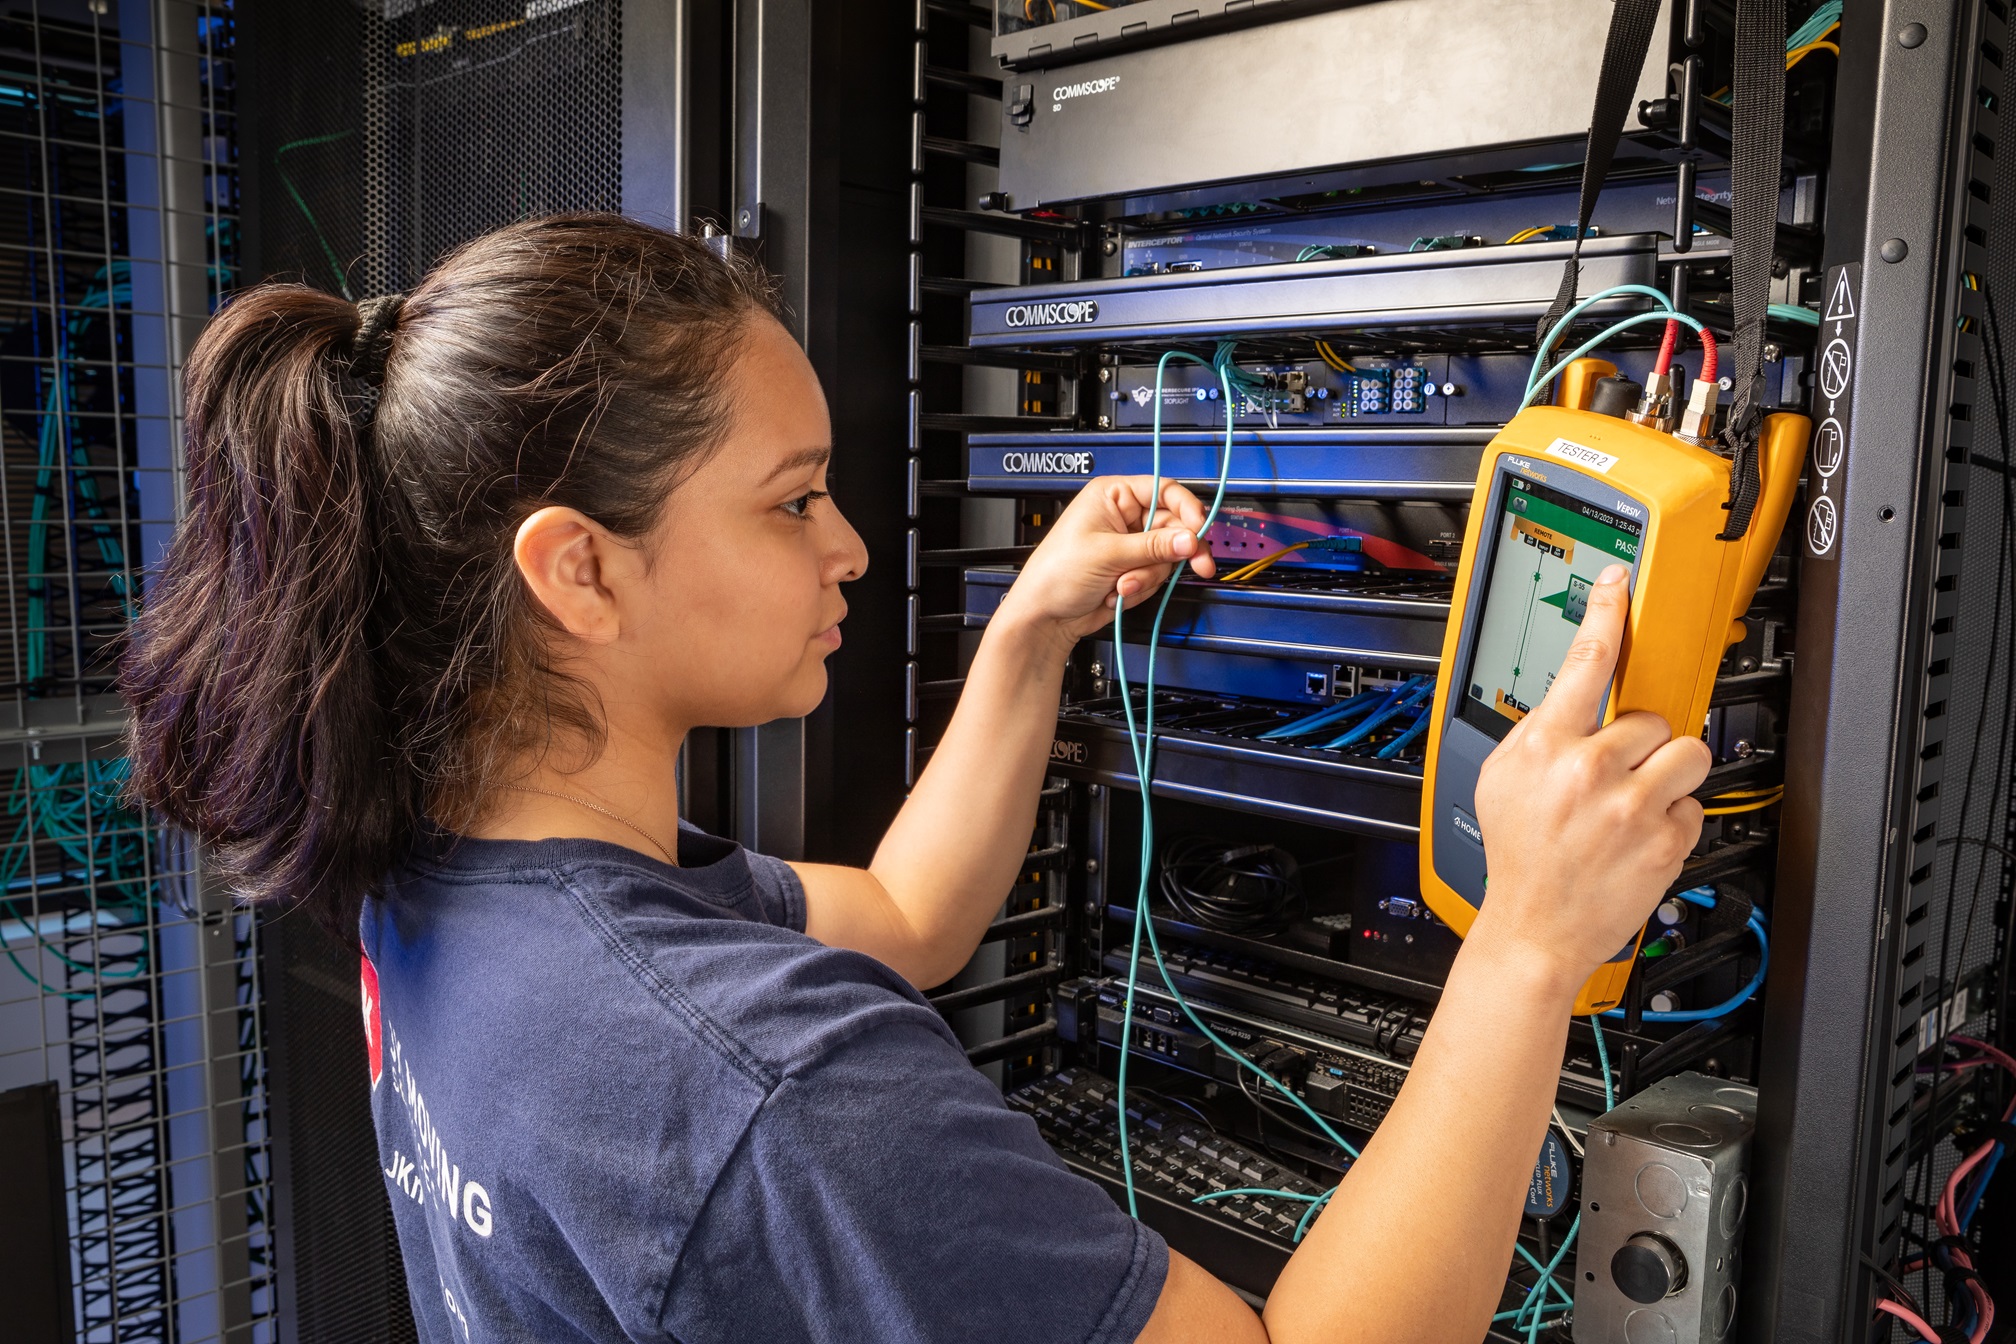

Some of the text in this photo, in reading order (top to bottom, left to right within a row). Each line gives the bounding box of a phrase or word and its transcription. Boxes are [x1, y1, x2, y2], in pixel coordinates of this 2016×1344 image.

[1128, 236, 1183, 248] INTERCEPTOR
[1195, 233, 1212, 241] Optical
[1213, 231, 1232, 239] Network
[1252, 228, 1272, 236] System
[1005, 301, 1094, 327] COMMSCOPE
[1003, 453, 1090, 474] COMMSCOPE
[1507, 455, 1531, 469] FLUKE
[1557, 442, 1608, 467] TESTER 2
[1520, 468, 1547, 482] networks
[1582, 506, 1613, 525] 04/13/2023
[1615, 519, 1635, 533] 1:25:43
[1534, 527, 1553, 540] REMOTE
[1615, 539, 1638, 556] PASS
[1461, 821, 1481, 840] HOME
[1210, 1022, 1251, 1040] PowerEdge R230
[405, 1059, 492, 1237] MOVING
[1548, 1141, 1558, 1178] FLUKE
[1544, 1165, 1553, 1208] networks
